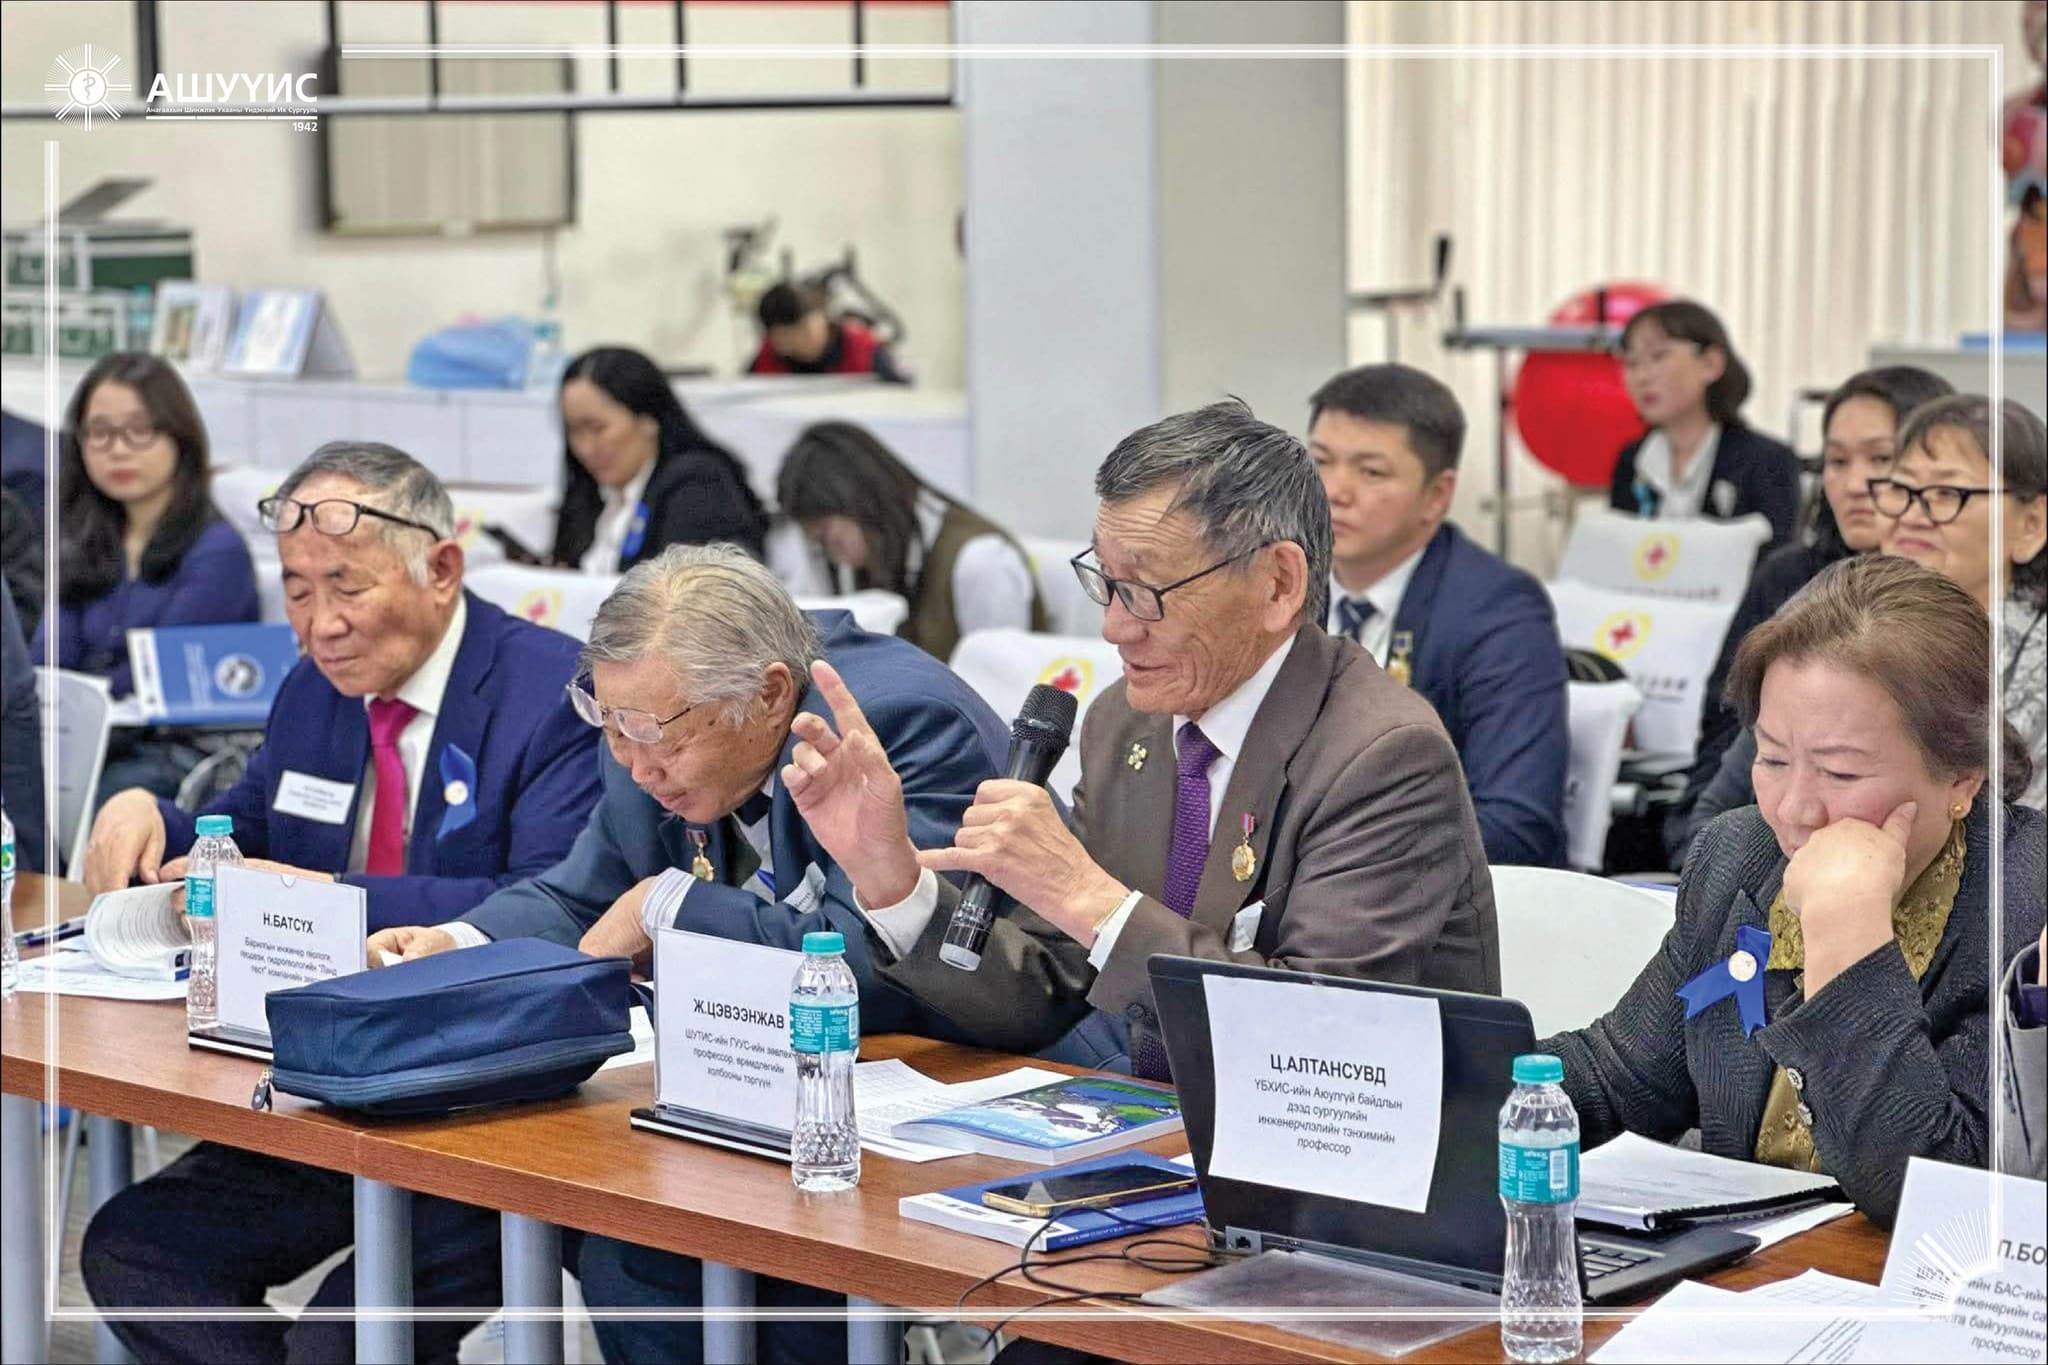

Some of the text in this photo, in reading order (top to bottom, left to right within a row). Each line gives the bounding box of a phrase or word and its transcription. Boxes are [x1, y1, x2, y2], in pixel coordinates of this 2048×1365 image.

[263, 912, 314, 935] Н.БАТСҮХ
[693, 998, 785, 1029] Ж.ЦЭВЭЭНЖАВ
[685, 1027, 729, 1047] ШУТИС-ийн
[1270, 1053, 1387, 1087] Ц.АЛТАНСУВД
[1254, 1078, 1403, 1110] ҮБХИС-ийн Аюулгүй байдлын
[1287, 1101, 1368, 1123] дээд сургуулийн
[1258, 1114, 1396, 1144] инженерчлэлийн тэнхимийн
[1297, 1135, 1352, 1156] профессор
[1971, 1336, 2041, 1360] профессор
